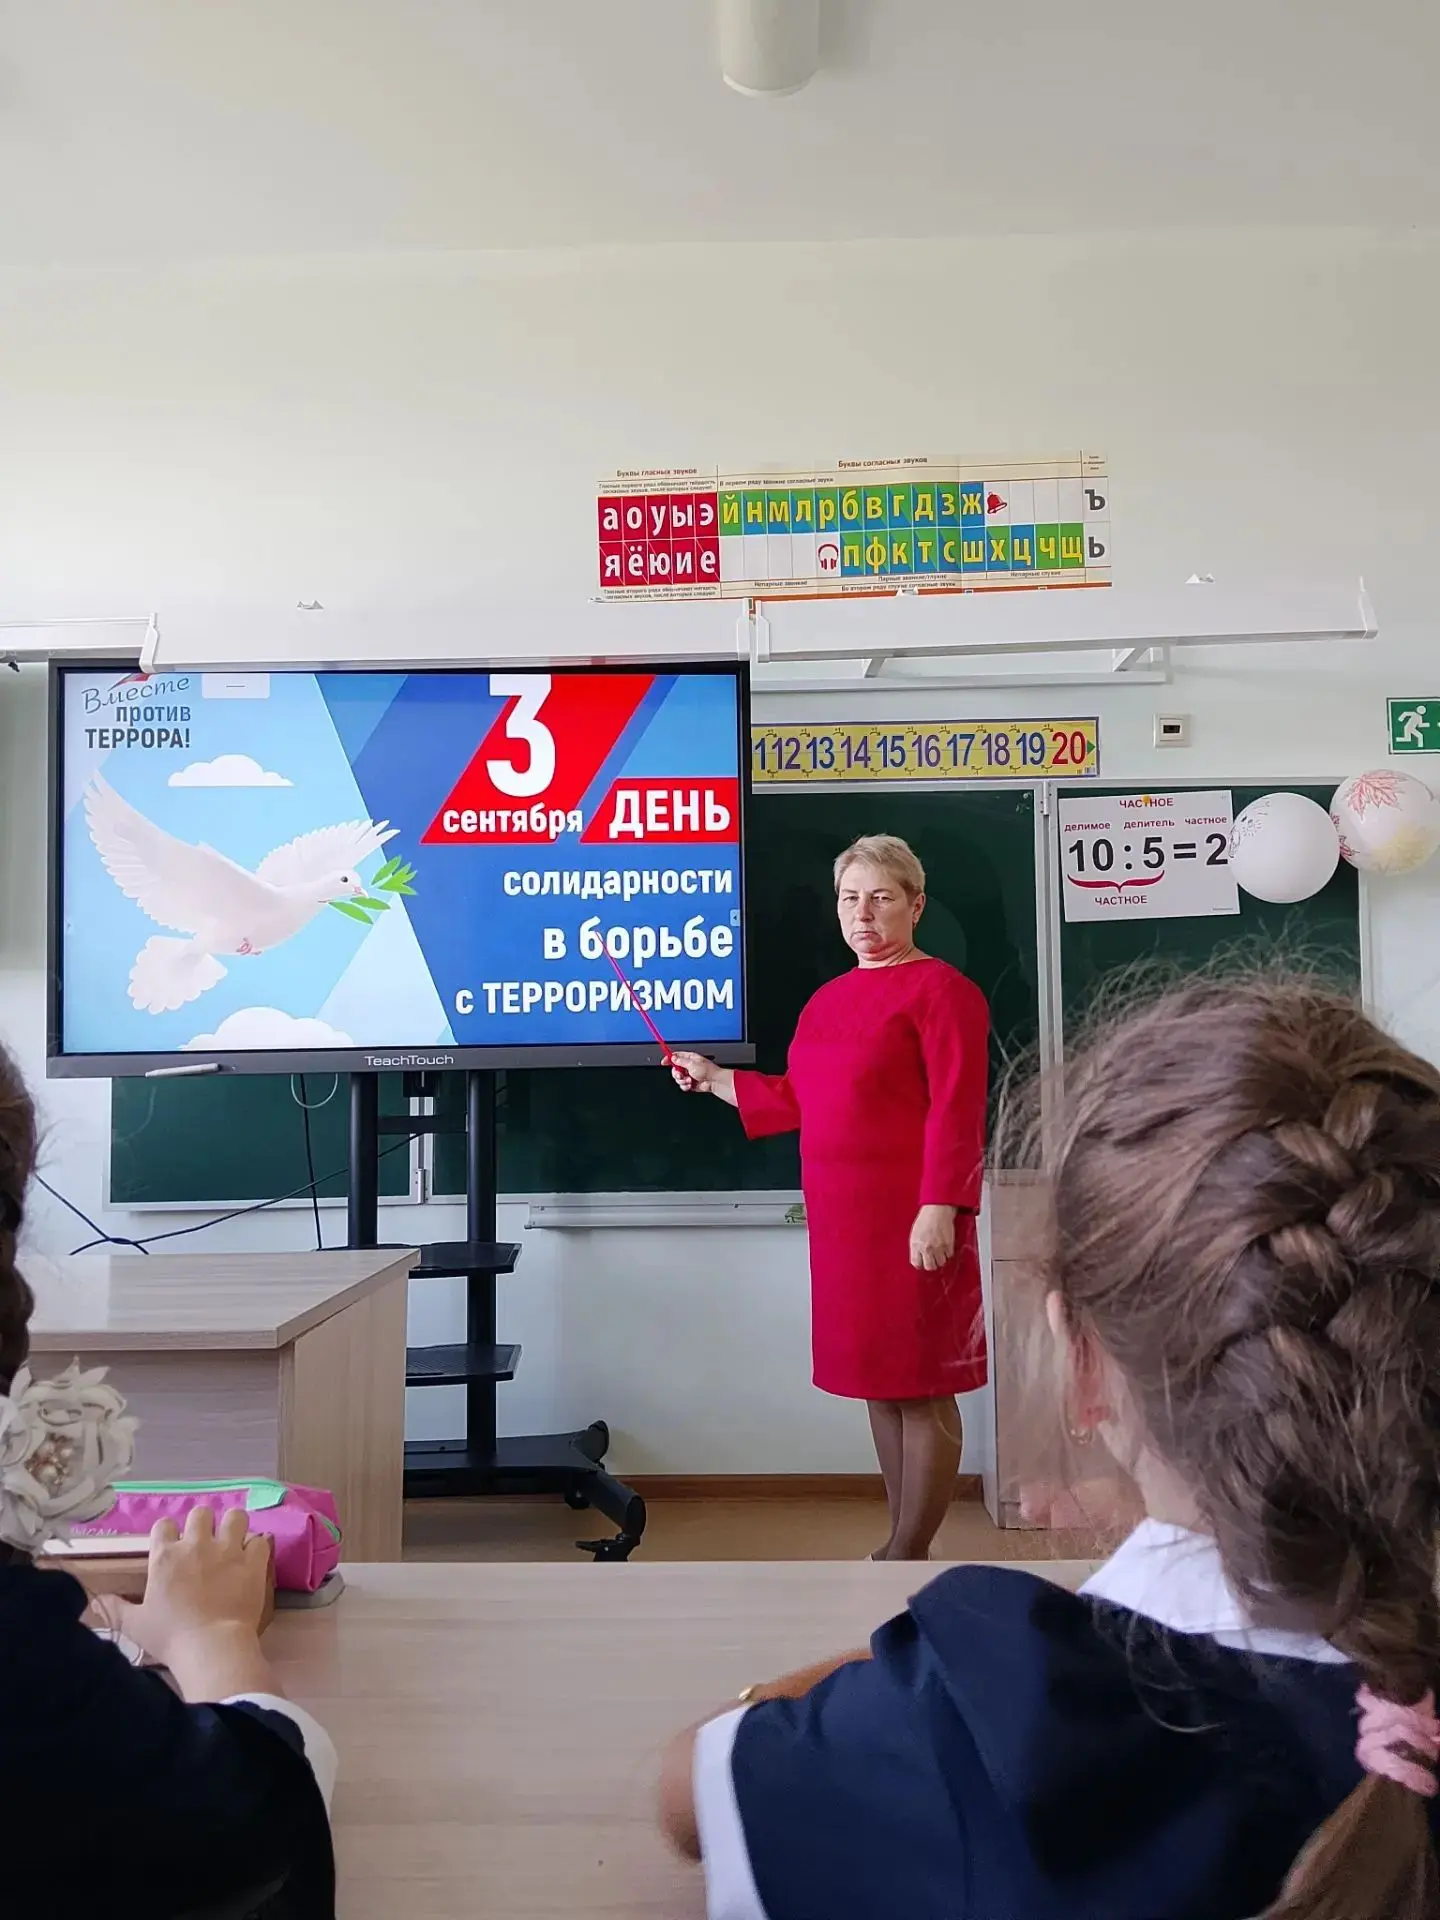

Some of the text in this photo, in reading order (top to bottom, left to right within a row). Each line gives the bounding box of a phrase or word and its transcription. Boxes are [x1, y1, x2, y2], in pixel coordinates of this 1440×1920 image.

[81, 676, 190, 714] Вместе
[116, 706, 191, 726] против
[85, 728, 190, 748] ТЕРРОРА!
[486, 674, 556, 797] 3
[772, 737, 801, 770] 12
[806, 736, 835, 769] 13
[840, 735, 871, 768] 14
[876, 735, 906, 768] 15
[911, 734, 940, 767] 16
[946, 733, 976, 766] 17
[981, 732, 1010, 766] 18
[1016, 732, 1045, 765] 19
[1051, 731, 1086, 765] 20
[442, 801, 583, 840] сентября
[608, 789, 731, 839] ДЕНЬ
[1064, 816, 1228, 832] делимое делитель частное
[1068, 838, 1114, 872] 10
[1143, 836, 1165, 868] 5
[1205, 833, 1229, 866] 2
[503, 869, 732, 902] солидарности
[1095, 894, 1148, 906] ЧАСТНОЕ
[543, 914, 733, 968] в борьбе
[455, 978, 734, 1014] с ТЕРРОРИЗМОМ
[364, 1054, 454, 1066] TeachTouch
